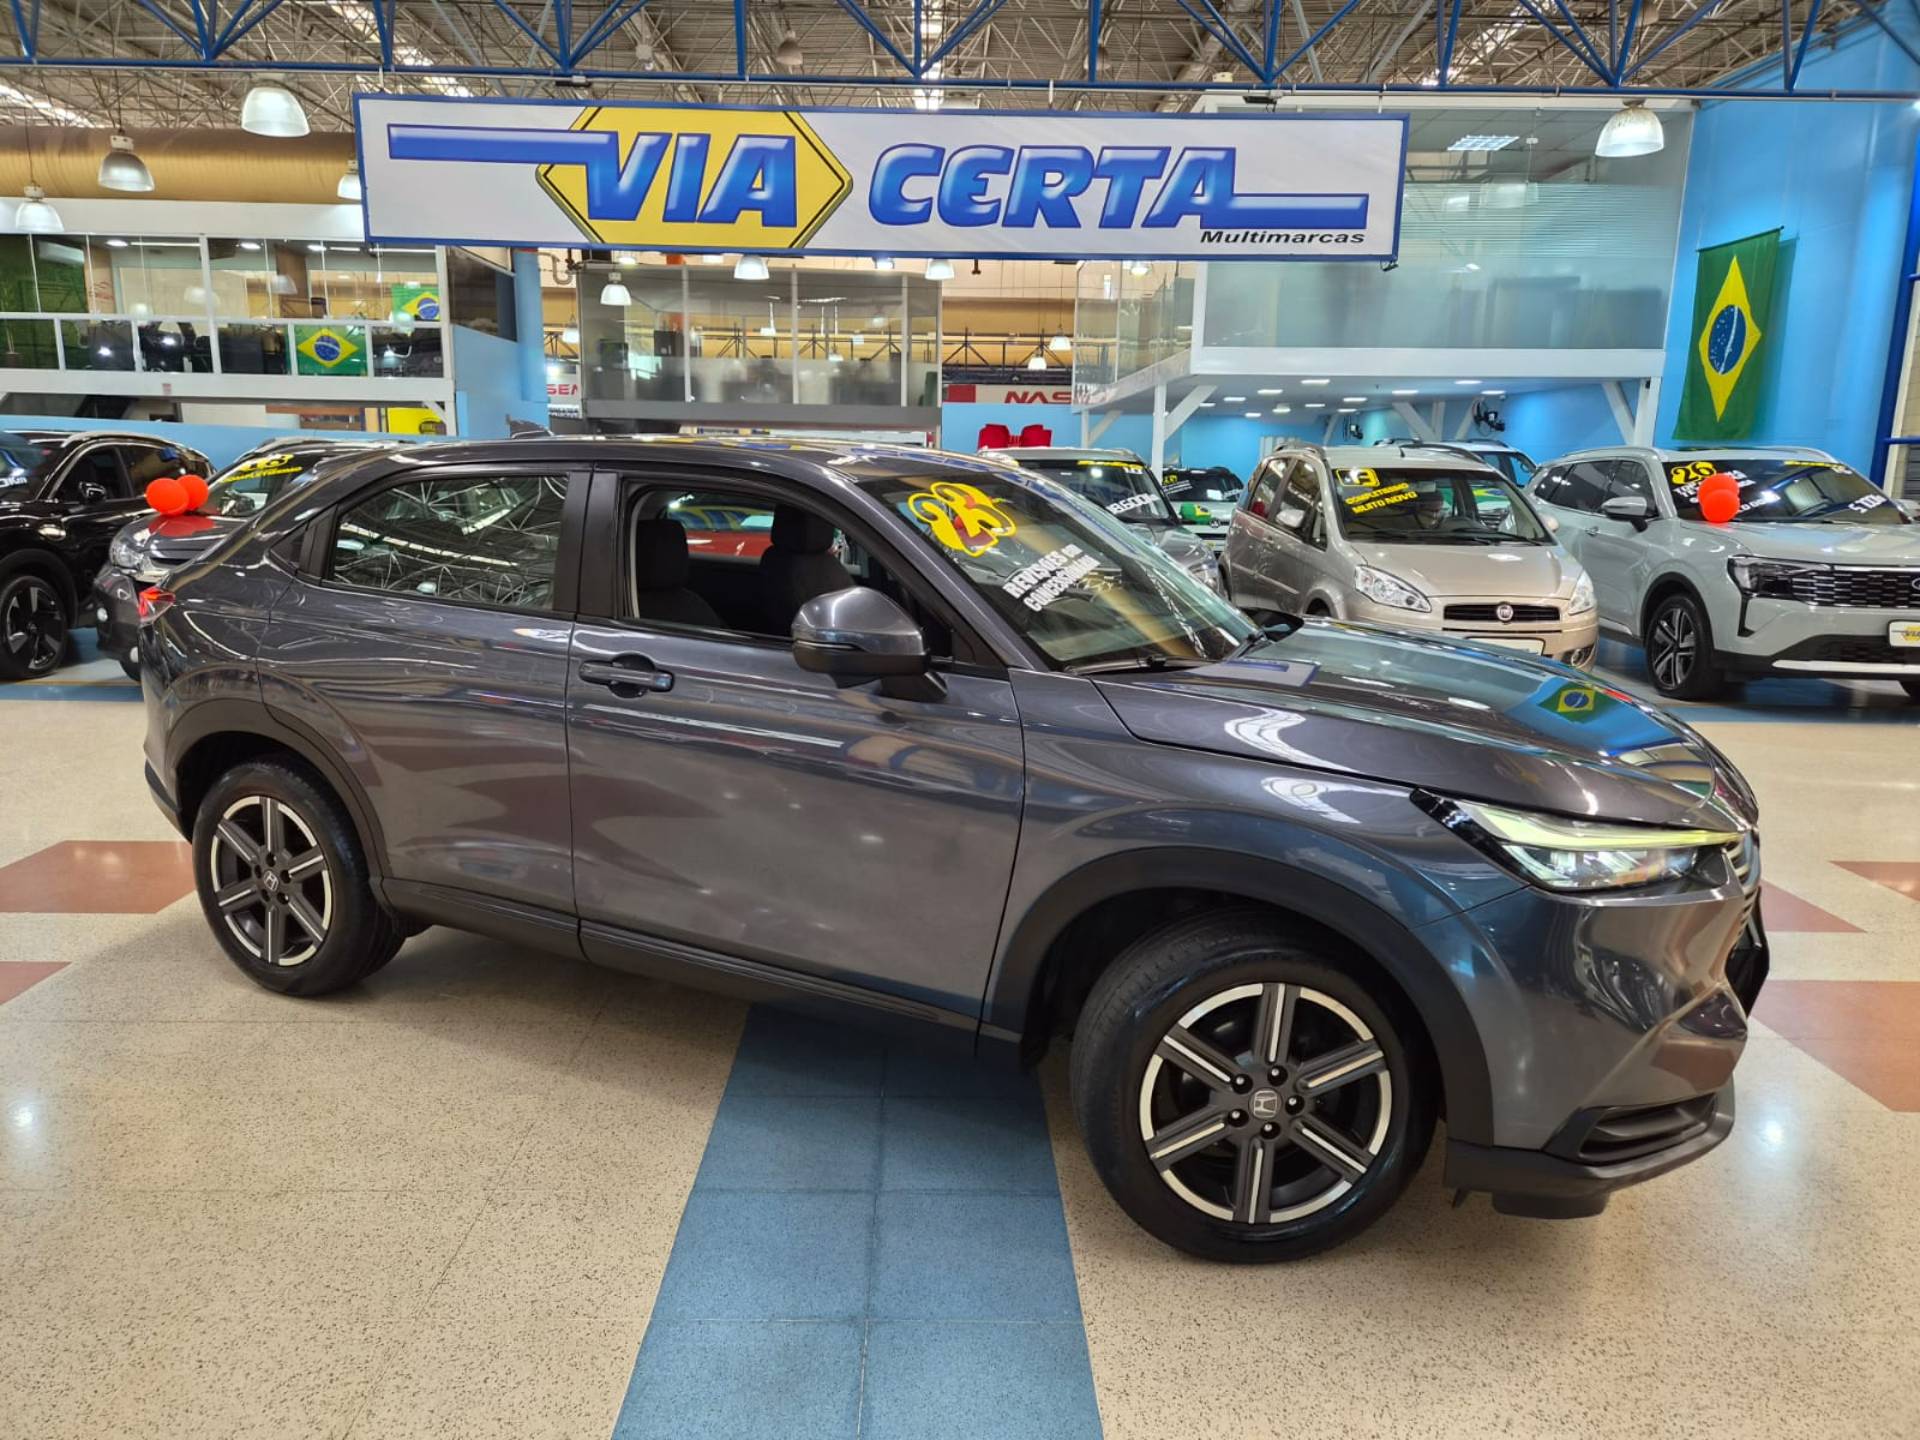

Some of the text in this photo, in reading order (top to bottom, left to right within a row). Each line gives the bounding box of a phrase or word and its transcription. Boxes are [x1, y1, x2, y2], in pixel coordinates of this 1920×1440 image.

[577, 131, 1237, 229] VIA CERTA
[1199, 230, 1366, 245] Multimarcas
[1670, 461, 1717, 485] 26
[1384, 491, 1419, 505] NOVO
